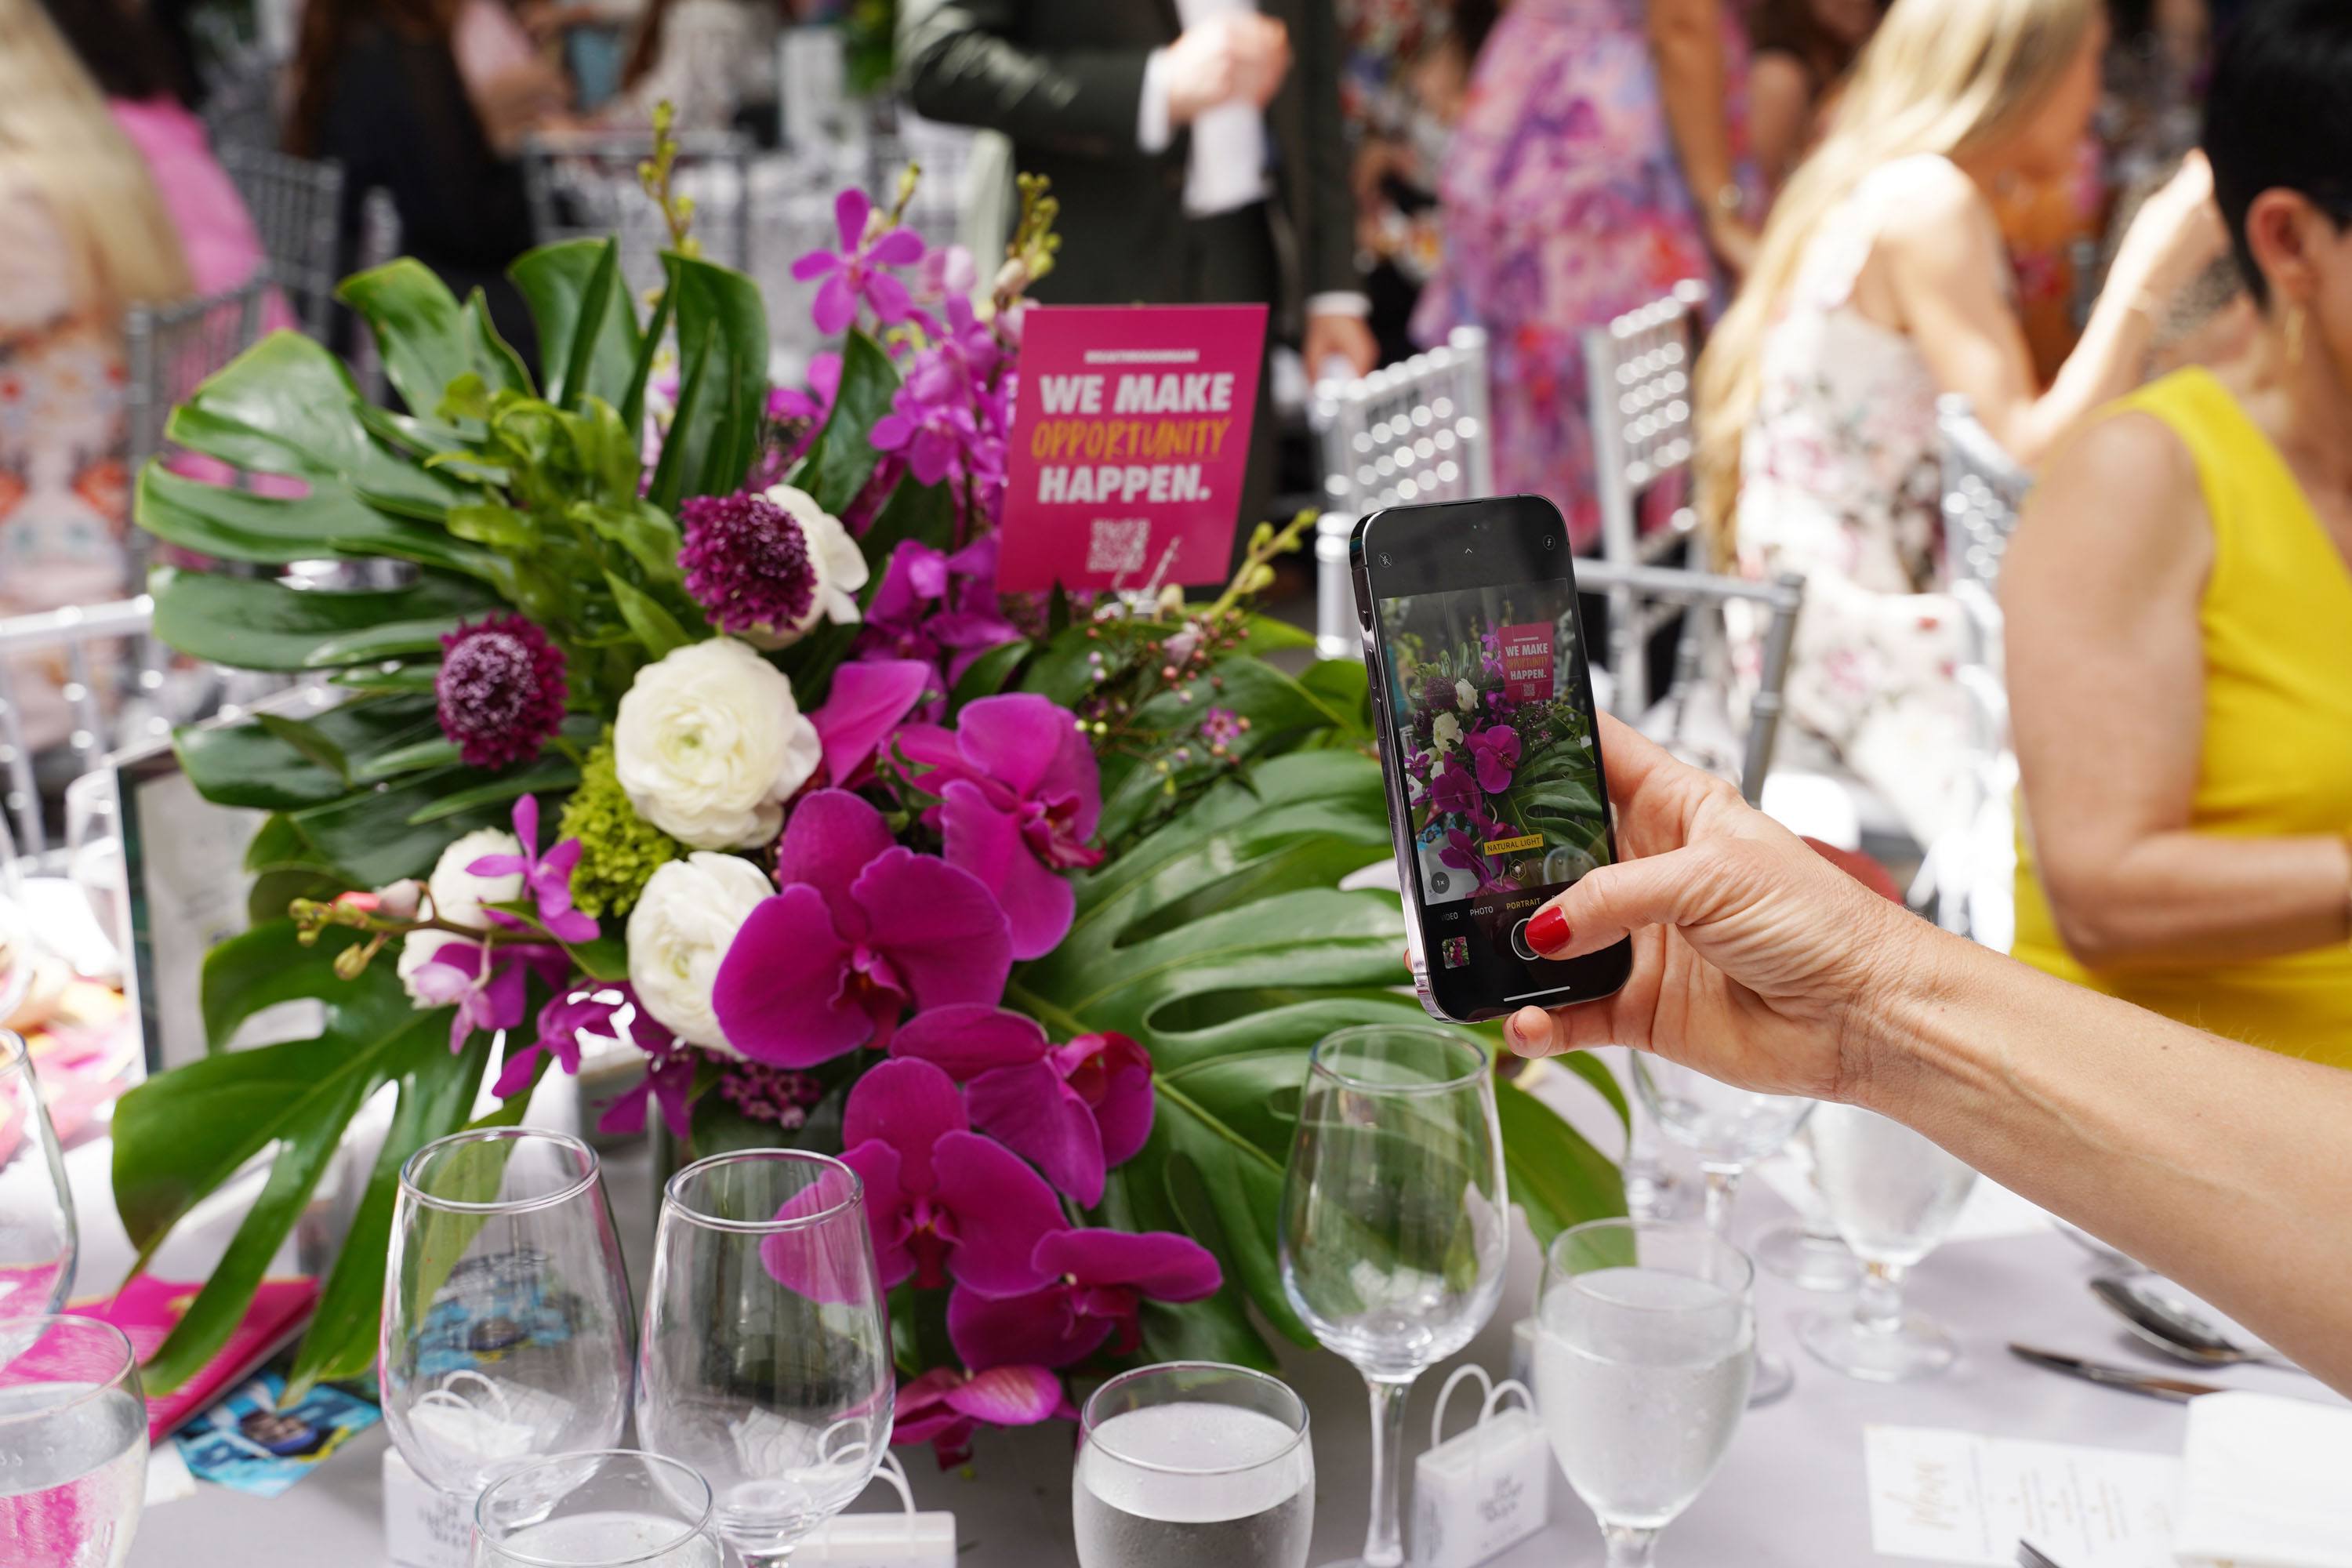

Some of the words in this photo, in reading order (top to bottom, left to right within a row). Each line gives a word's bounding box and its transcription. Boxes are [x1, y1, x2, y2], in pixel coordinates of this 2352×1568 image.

[1039, 374, 1105, 415] WE
[1114, 372, 1235, 414] MAKE
[1030, 417, 1232, 462] OPPORTUNITY
[1037, 463, 1212, 504] HAPPEN.
[1505, 645, 1519, 657] WE
[1522, 643, 1548, 655] MAKE
[1510, 669, 1547, 681] HAPPEN.
[1487, 840, 1519, 852] NATURAL
[1521, 837, 1541, 848] LIGHT
[1506, 897, 1541, 909] PORTRAIT
[1469, 906, 1494, 916] PHOTO
